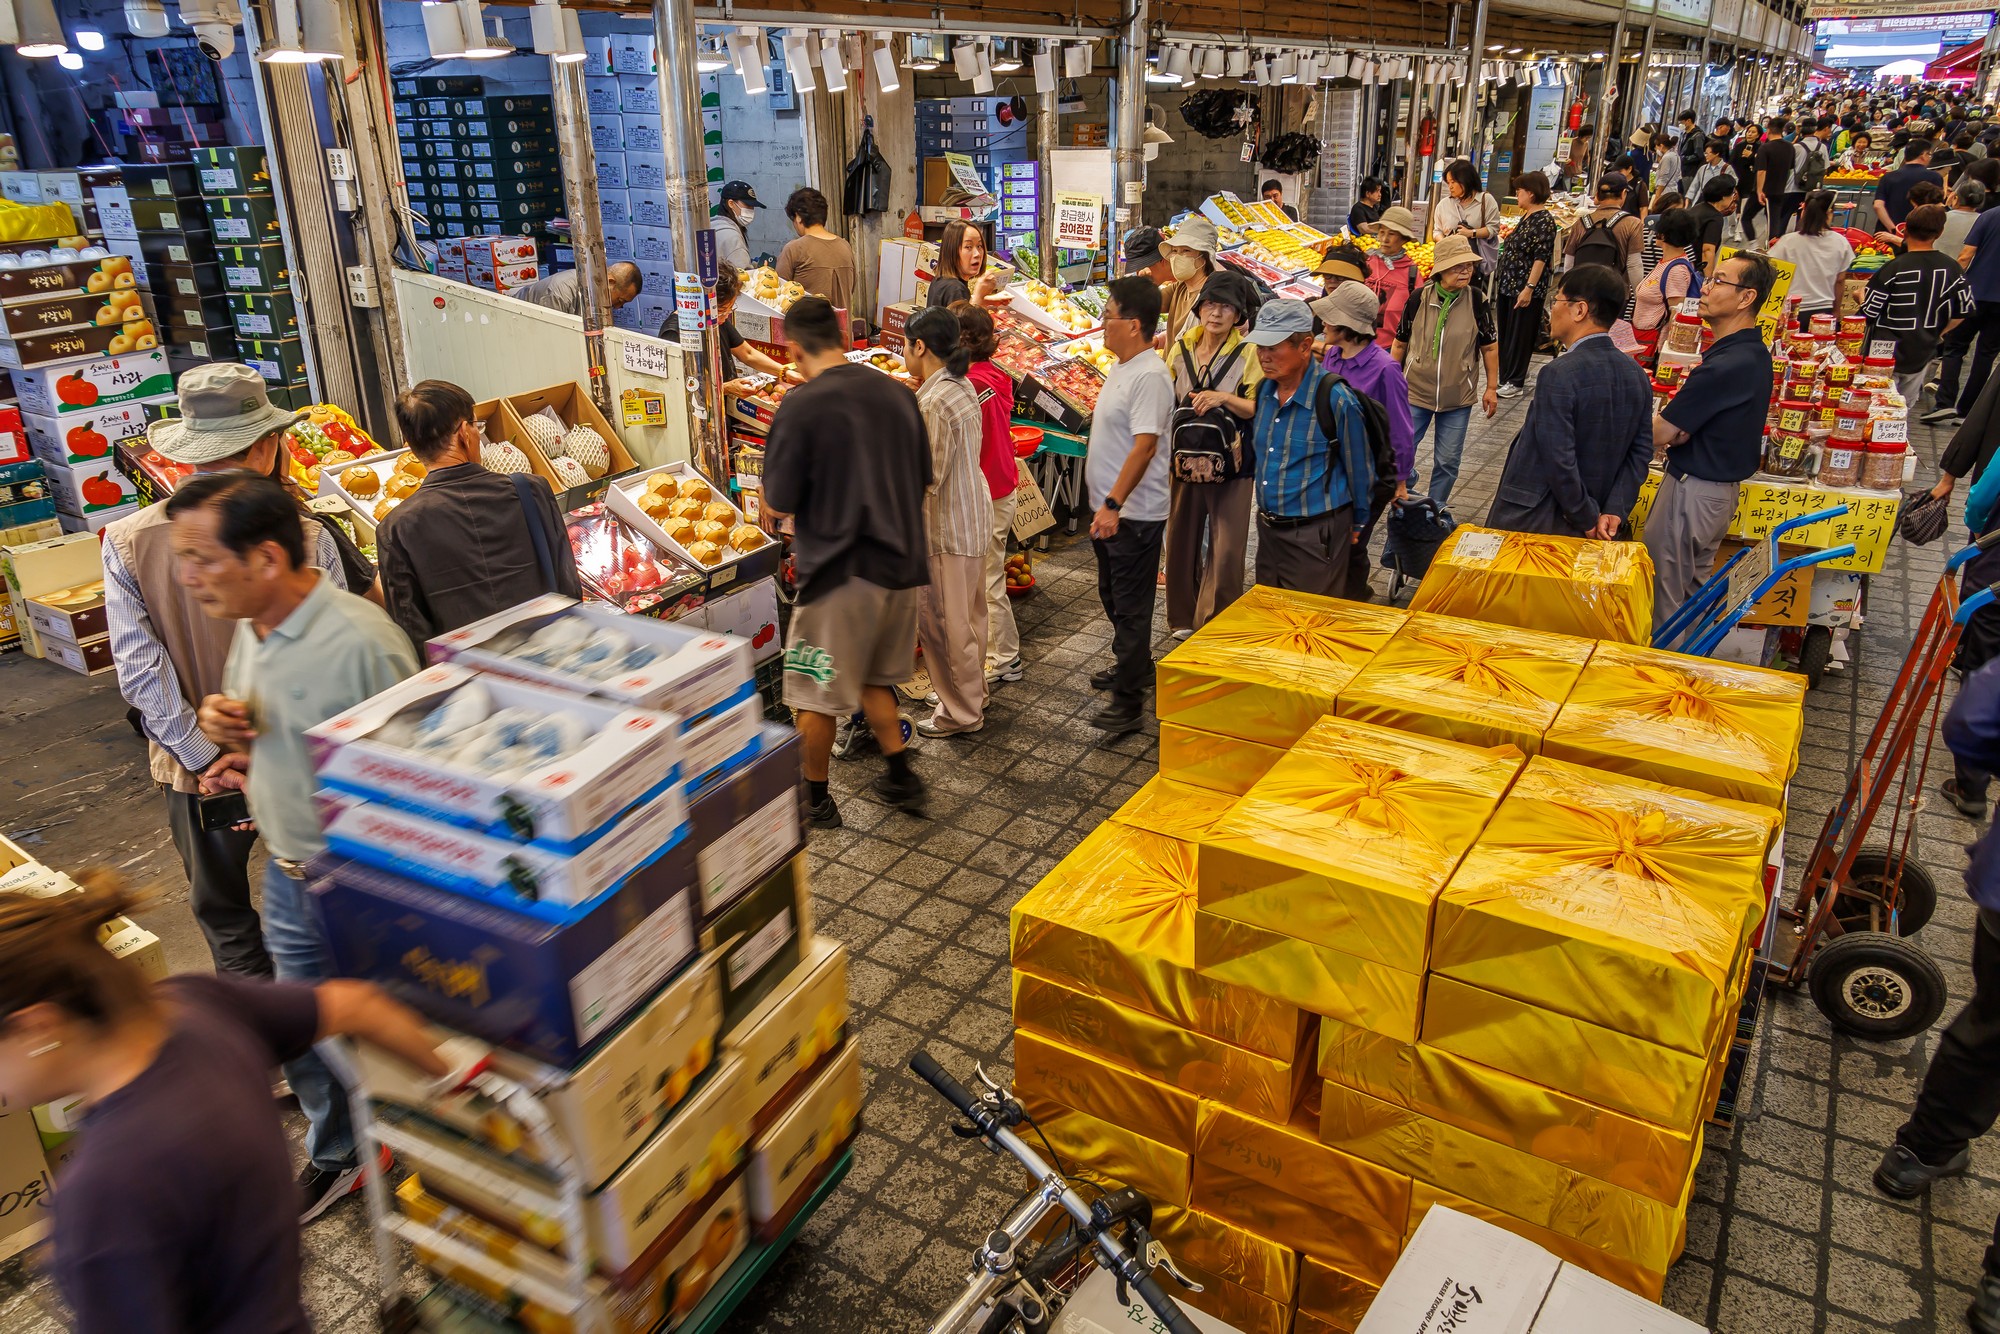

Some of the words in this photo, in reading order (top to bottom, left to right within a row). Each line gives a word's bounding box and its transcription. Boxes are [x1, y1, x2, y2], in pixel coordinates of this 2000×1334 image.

[1060, 209, 1095, 223] 환급행사
[1059, 222, 1093, 236] 참여점포
[112, 371, 143, 386] 사과
[1784, 412, 1802, 422] 오징어
[1758, 489, 1827, 509] 오징어젓
[1834, 524, 1883, 545] 꼴뚜기
[1438, 1276, 1454, 1297] FRESH
[1424, 1296, 1443, 1323] YEONGJU
[1436, 1282, 1483, 1334] 소백산
